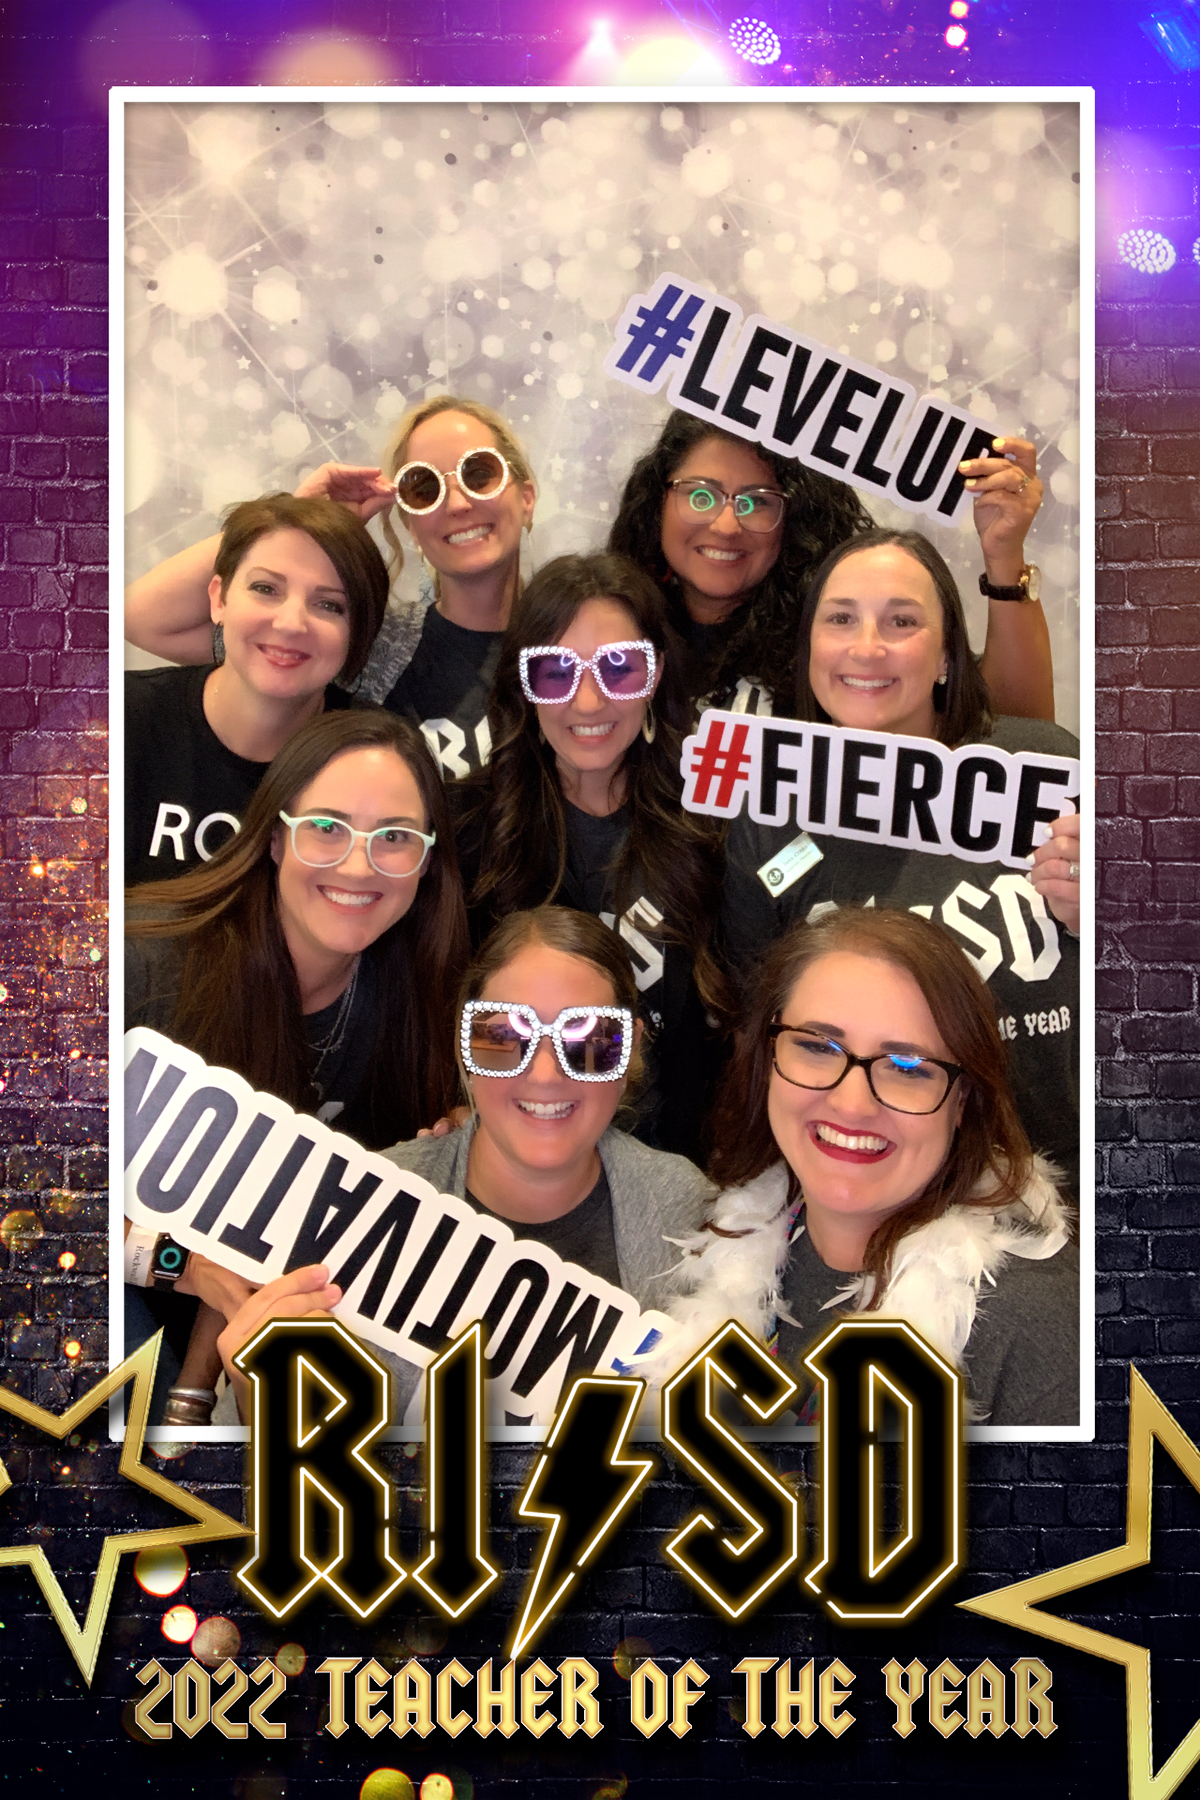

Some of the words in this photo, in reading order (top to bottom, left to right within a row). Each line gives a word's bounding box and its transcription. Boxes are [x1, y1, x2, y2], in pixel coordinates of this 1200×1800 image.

[615, 283, 1006, 517] #LEVELUP
[690, 719, 1071, 859] #FIERCE
[1023, 1005, 1071, 1037] YEAR
[124, 1046, 663, 1415] MOTIVATION
